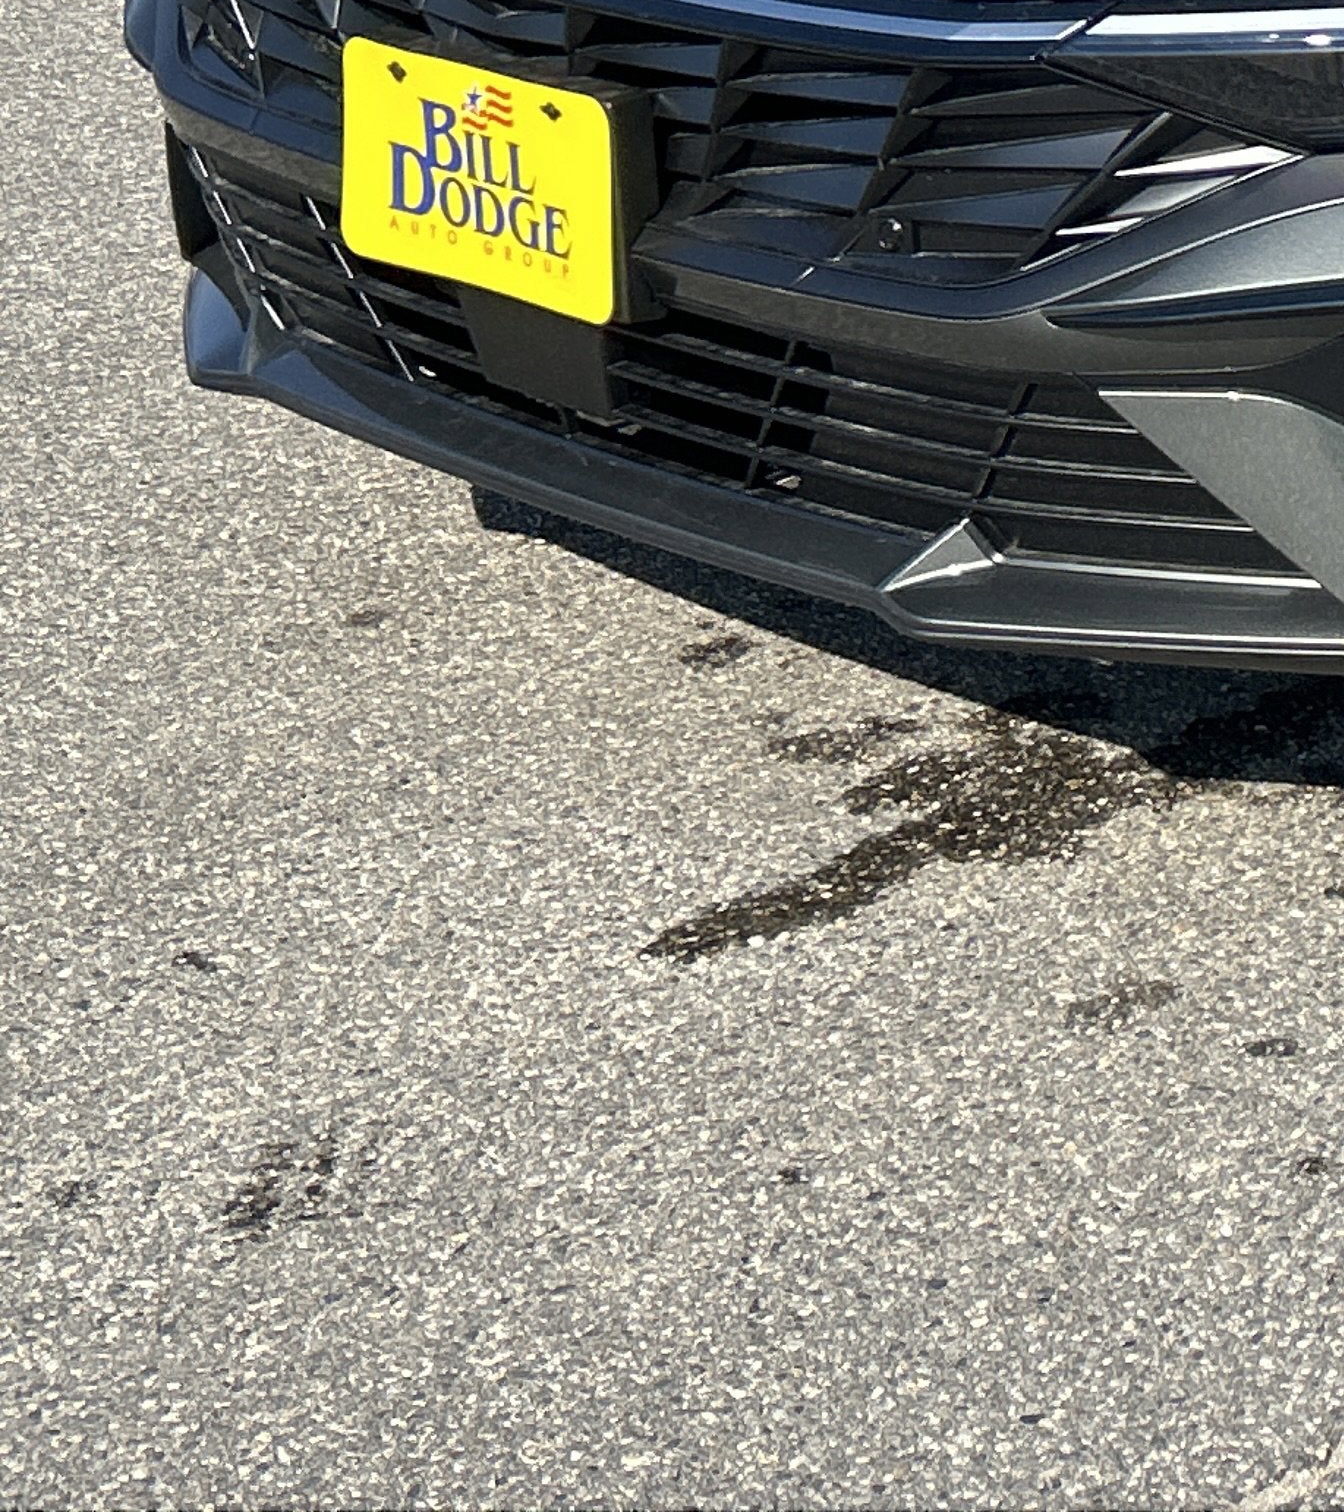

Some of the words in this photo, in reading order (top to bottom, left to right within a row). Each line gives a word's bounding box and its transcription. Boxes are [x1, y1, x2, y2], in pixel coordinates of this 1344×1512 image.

[418, 96, 537, 196] BILL
[387, 140, 573, 260] DODGE
[388, 215, 459, 245] AUTO
[483, 239, 570, 278] GROUP
